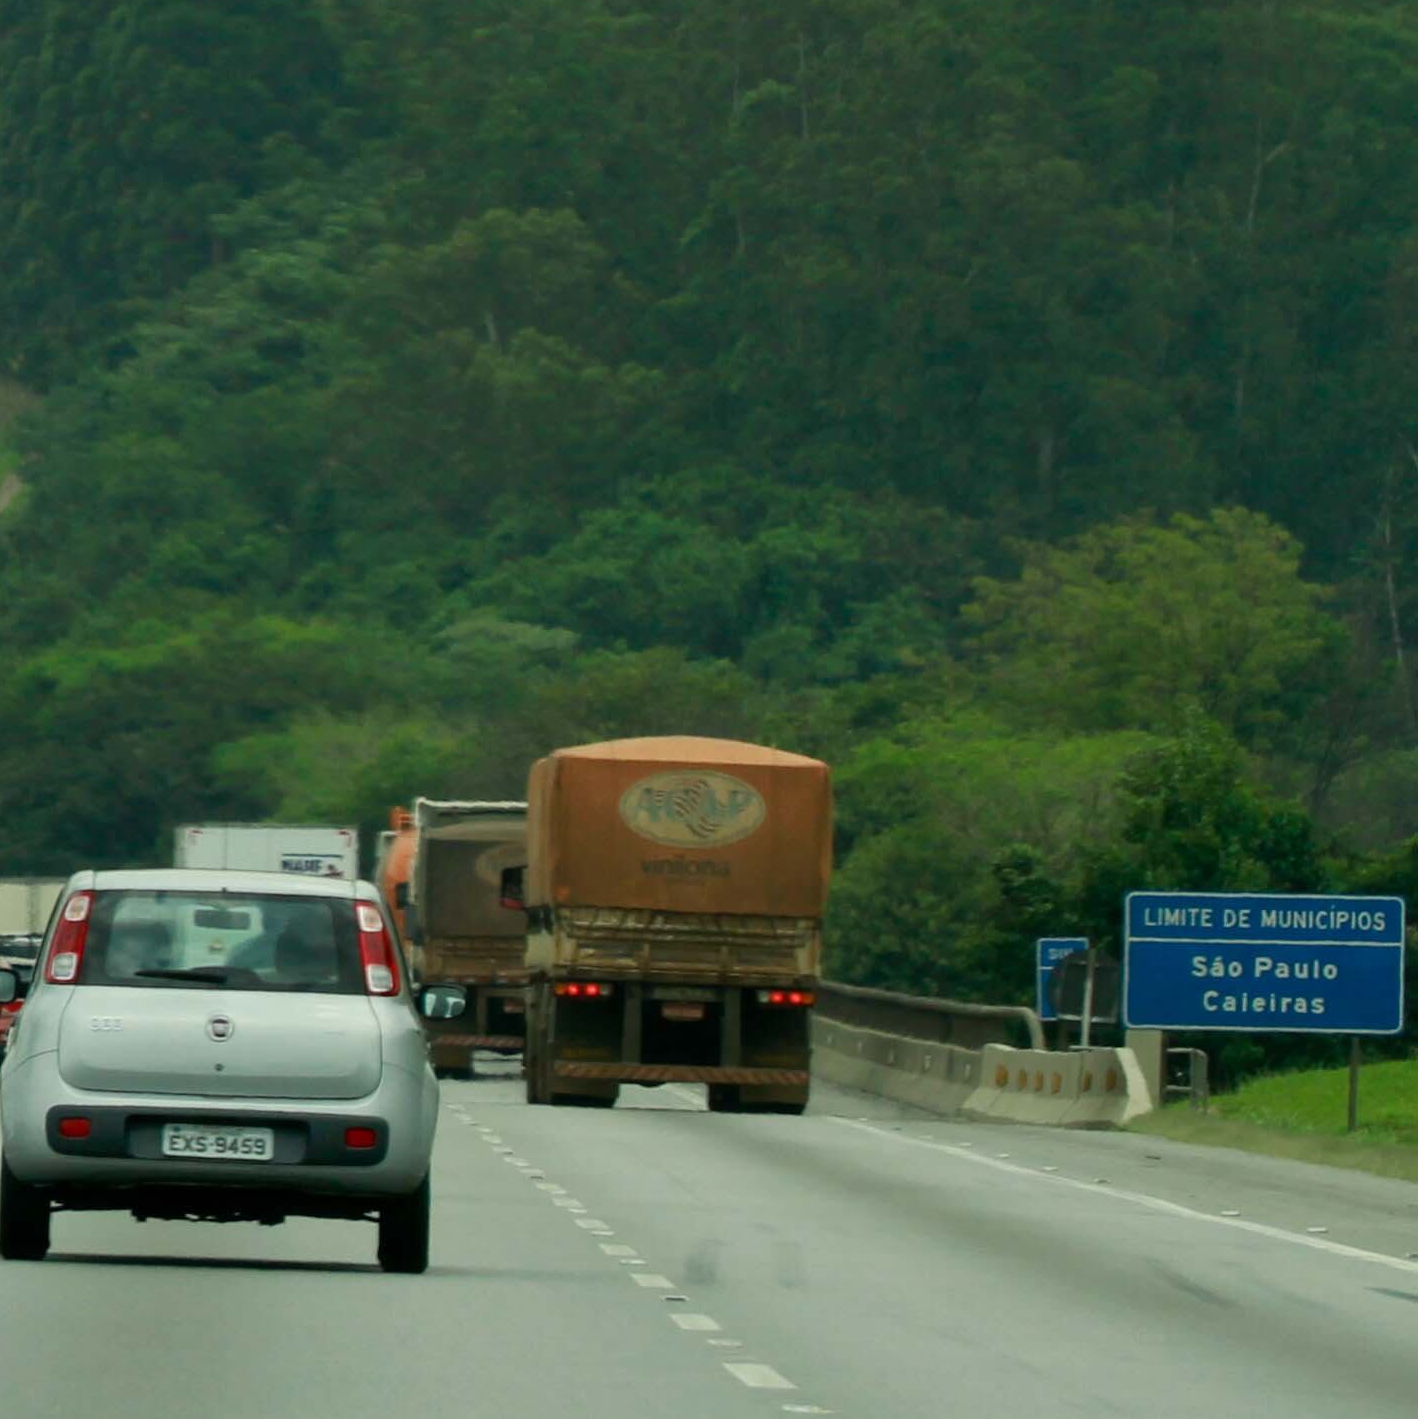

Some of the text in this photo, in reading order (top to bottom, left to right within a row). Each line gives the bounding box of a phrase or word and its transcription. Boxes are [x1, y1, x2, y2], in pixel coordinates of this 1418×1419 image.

[1144, 904, 1386, 931] LIMITE DE MUNICÍPIOS
[1254, 957, 1339, 980] Paulo
[1203, 990, 1326, 1014] Caieiras
[168, 1134, 266, 1156] EXS-9459
